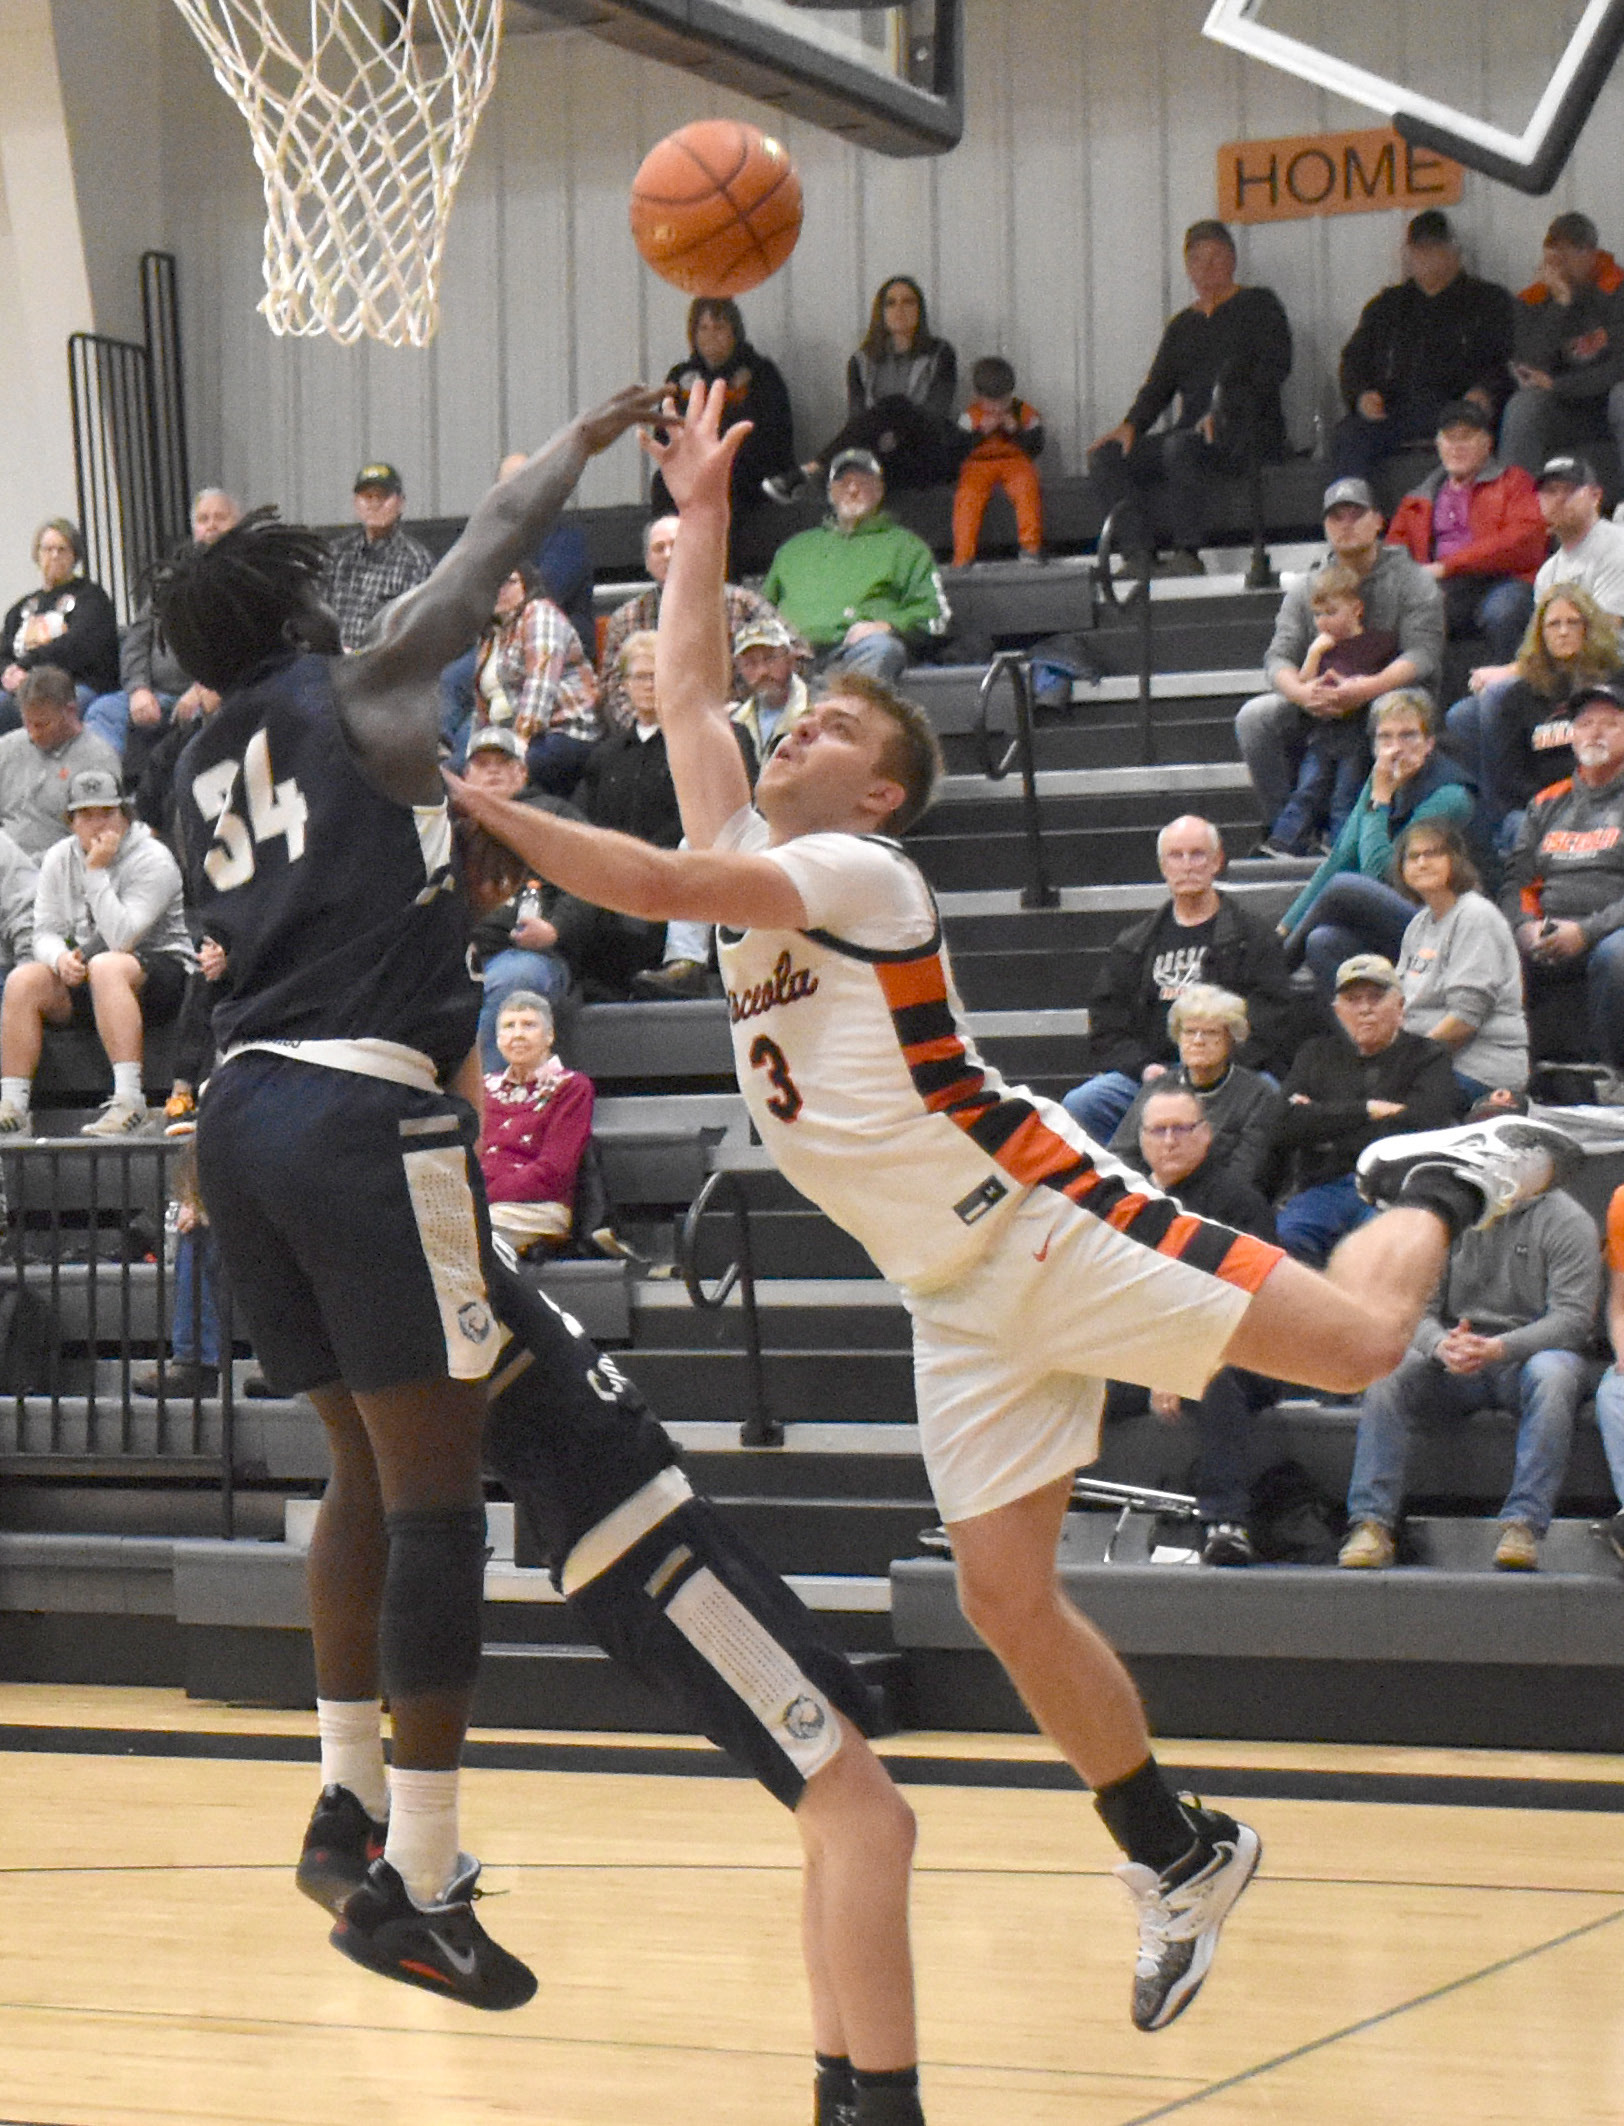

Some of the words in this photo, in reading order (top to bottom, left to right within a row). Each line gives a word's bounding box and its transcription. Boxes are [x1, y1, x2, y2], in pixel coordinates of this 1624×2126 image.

[1235, 142, 1445, 210] HOME
[192, 727, 308, 892] 34
[751, 1034, 803, 1124] 3
